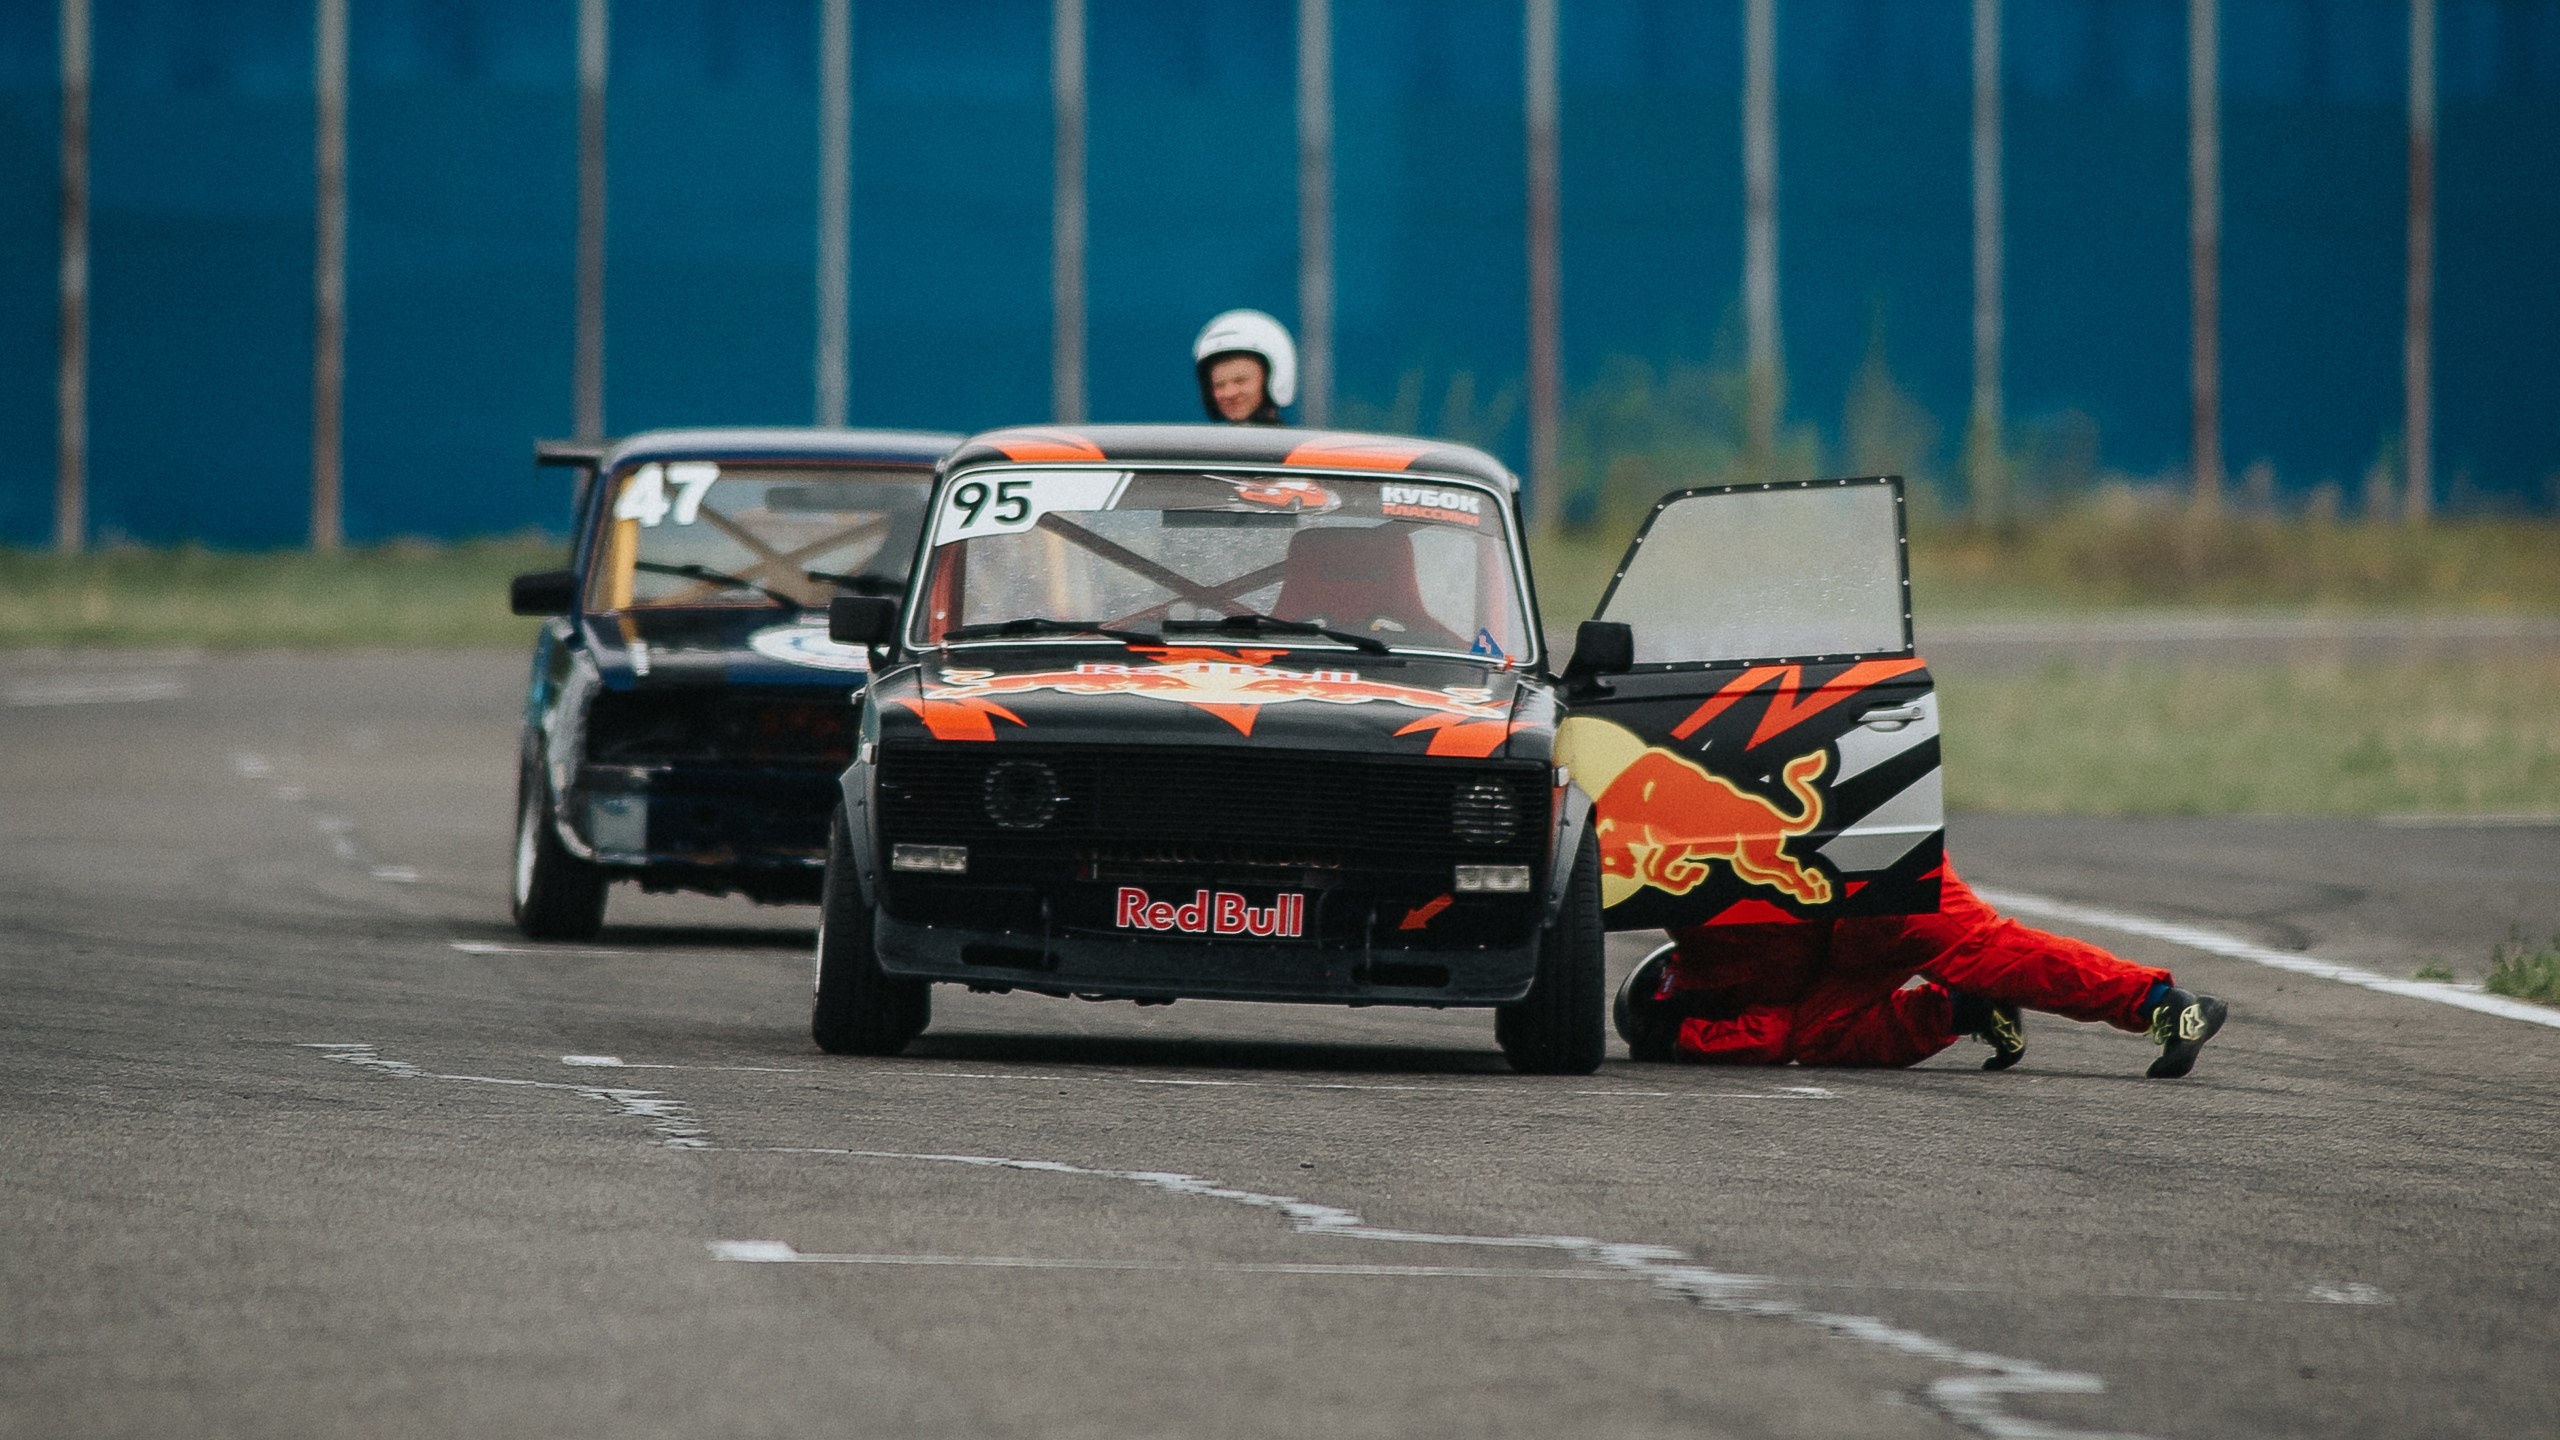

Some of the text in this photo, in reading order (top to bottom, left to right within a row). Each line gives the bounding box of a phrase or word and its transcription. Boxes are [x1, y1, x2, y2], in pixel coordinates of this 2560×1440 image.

[613, 462, 720, 527] 47
[953, 481, 1032, 529] 95
[1382, 486, 1480, 514] КУБОК
[1116, 887, 1304, 936] Red Bull
